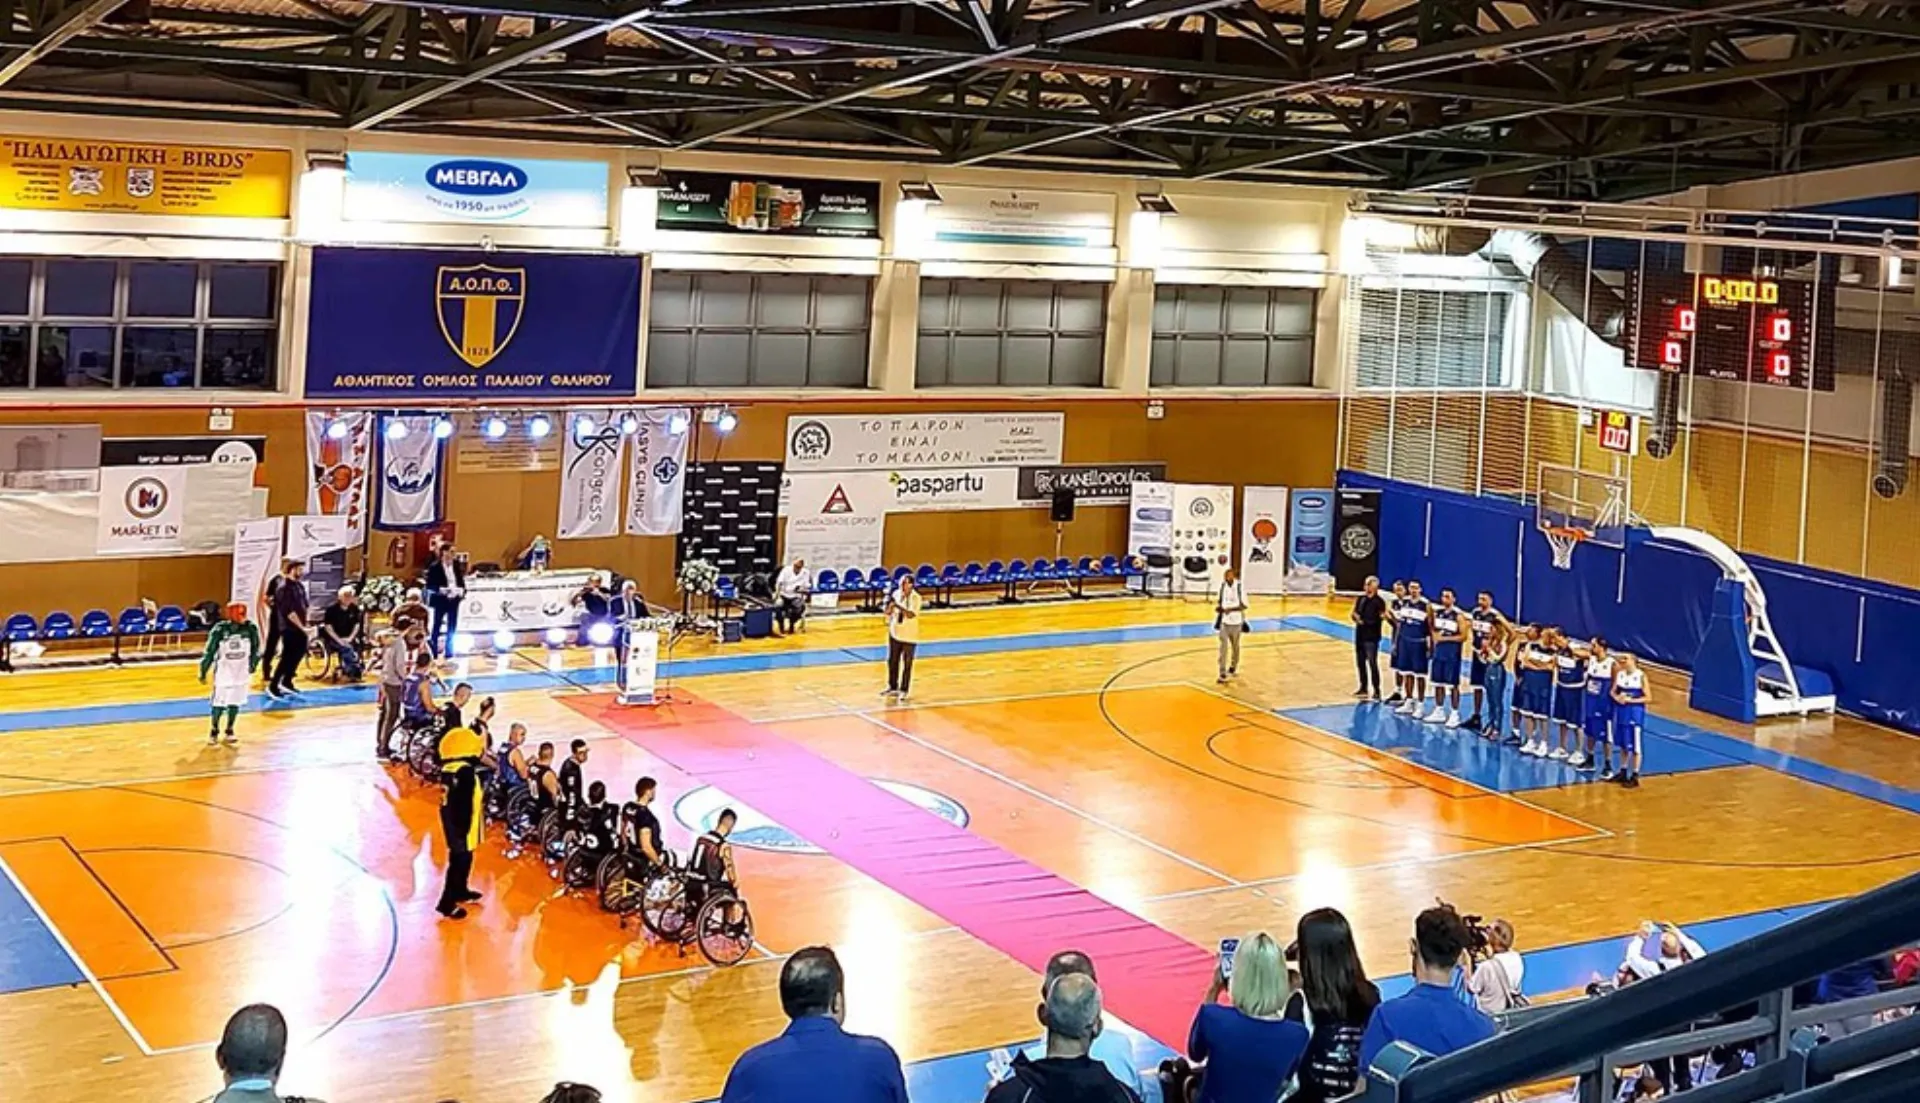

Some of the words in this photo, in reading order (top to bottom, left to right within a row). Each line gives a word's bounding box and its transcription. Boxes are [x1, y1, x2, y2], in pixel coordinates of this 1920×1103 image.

[435, 168, 518, 187] ΜΕΒΓΑΛ
[455, 199, 483, 211] 1950
[1680, 310, 1696, 332] 0
[1773, 318, 1792, 342] 0
[1664, 342, 1682, 364] 0
[1774, 354, 1791, 377] 0
[333, 375, 416, 388] ΑΘΛΗΤΙΚΟΣ
[422, 375, 479, 387] ΟΜΙΛΟΣ
[485, 375, 545, 387] ΠΑΛΑΙΟΥ
[550, 374, 613, 386] ΦΑΛΗΡΟΥ
[634, 470, 647, 518] CLINIC
[896, 472, 984, 497] paspartu
